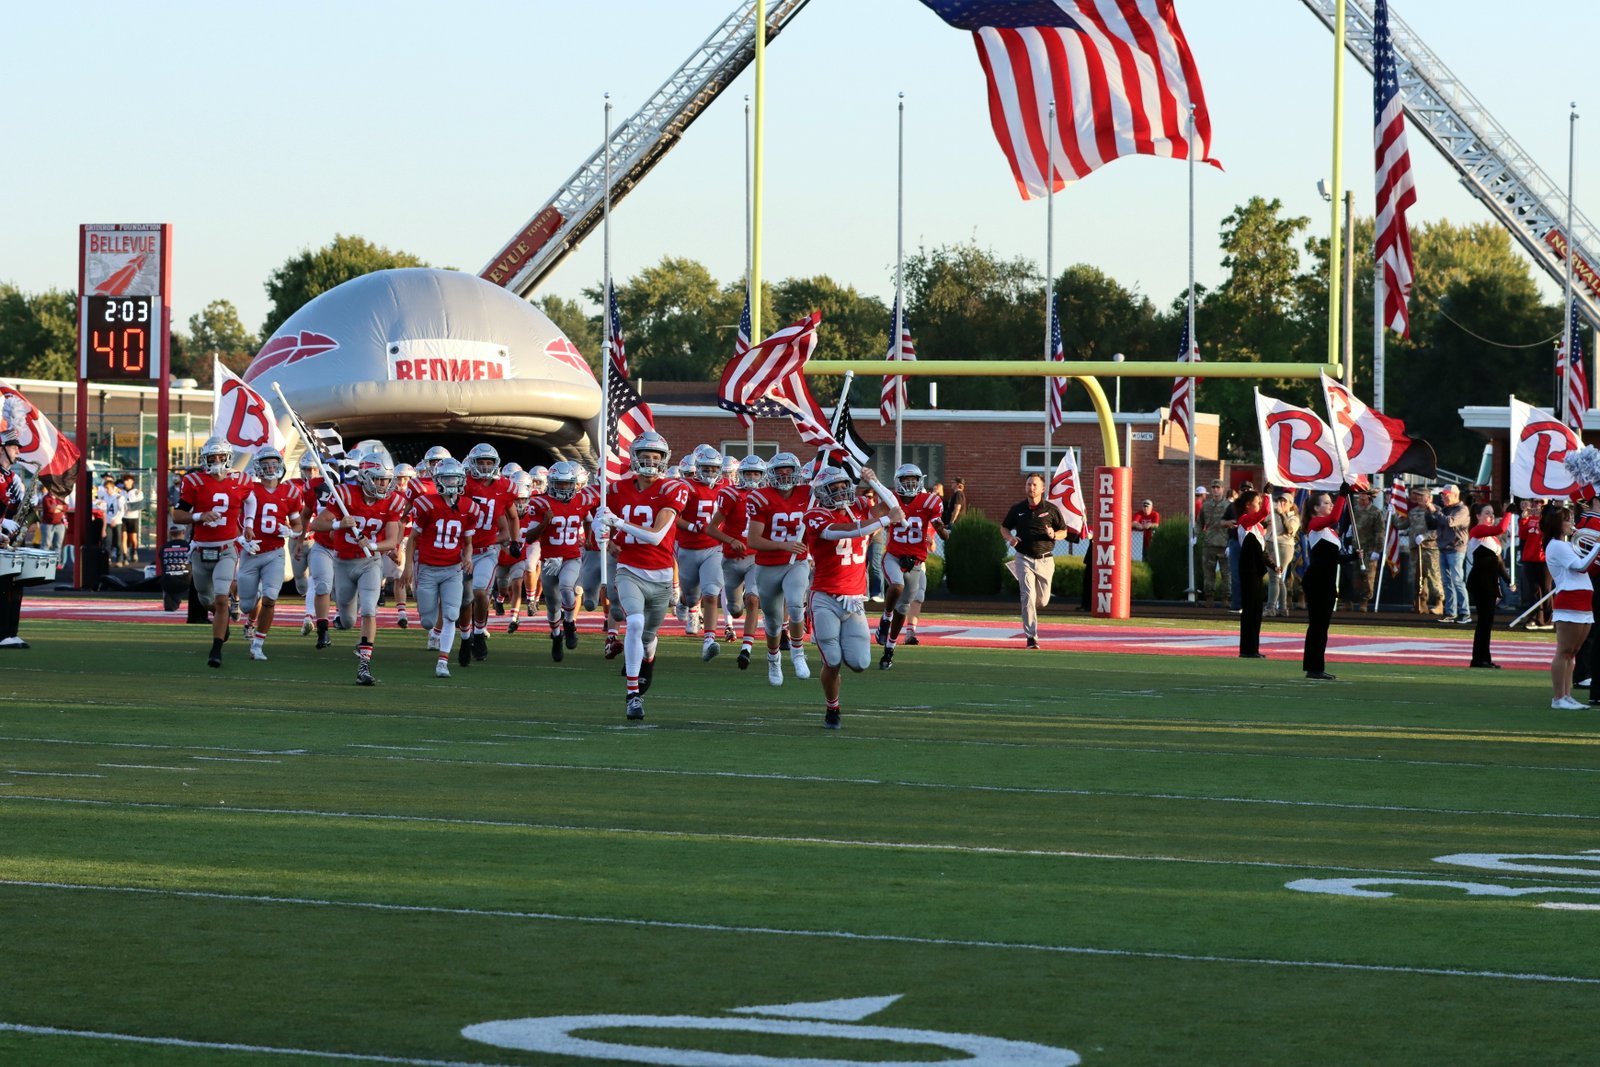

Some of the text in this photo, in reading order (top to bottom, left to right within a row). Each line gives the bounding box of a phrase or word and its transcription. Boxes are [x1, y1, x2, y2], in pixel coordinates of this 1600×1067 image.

[119, 223, 161, 231] FOUNDATION
[527, 210, 553, 237] TOWER
[90, 233, 155, 254] BELLEVUE
[1551, 235, 1600, 293] NORWAL
[105, 301, 148, 322] 2:03
[94, 328, 145, 371] 40
[395, 358, 504, 382] REDMEN
[1132, 432, 1153, 440] WOMEN
[1265, 410, 1334, 483] B
[212, 493, 230, 526] 2
[675, 488, 689, 505] 13
[261, 503, 278, 534] 6
[433, 518, 462, 549] 10
[549, 515, 580, 546] 36
[770, 511, 806, 543] 63
[1096, 473, 1116, 614] REDMEN
